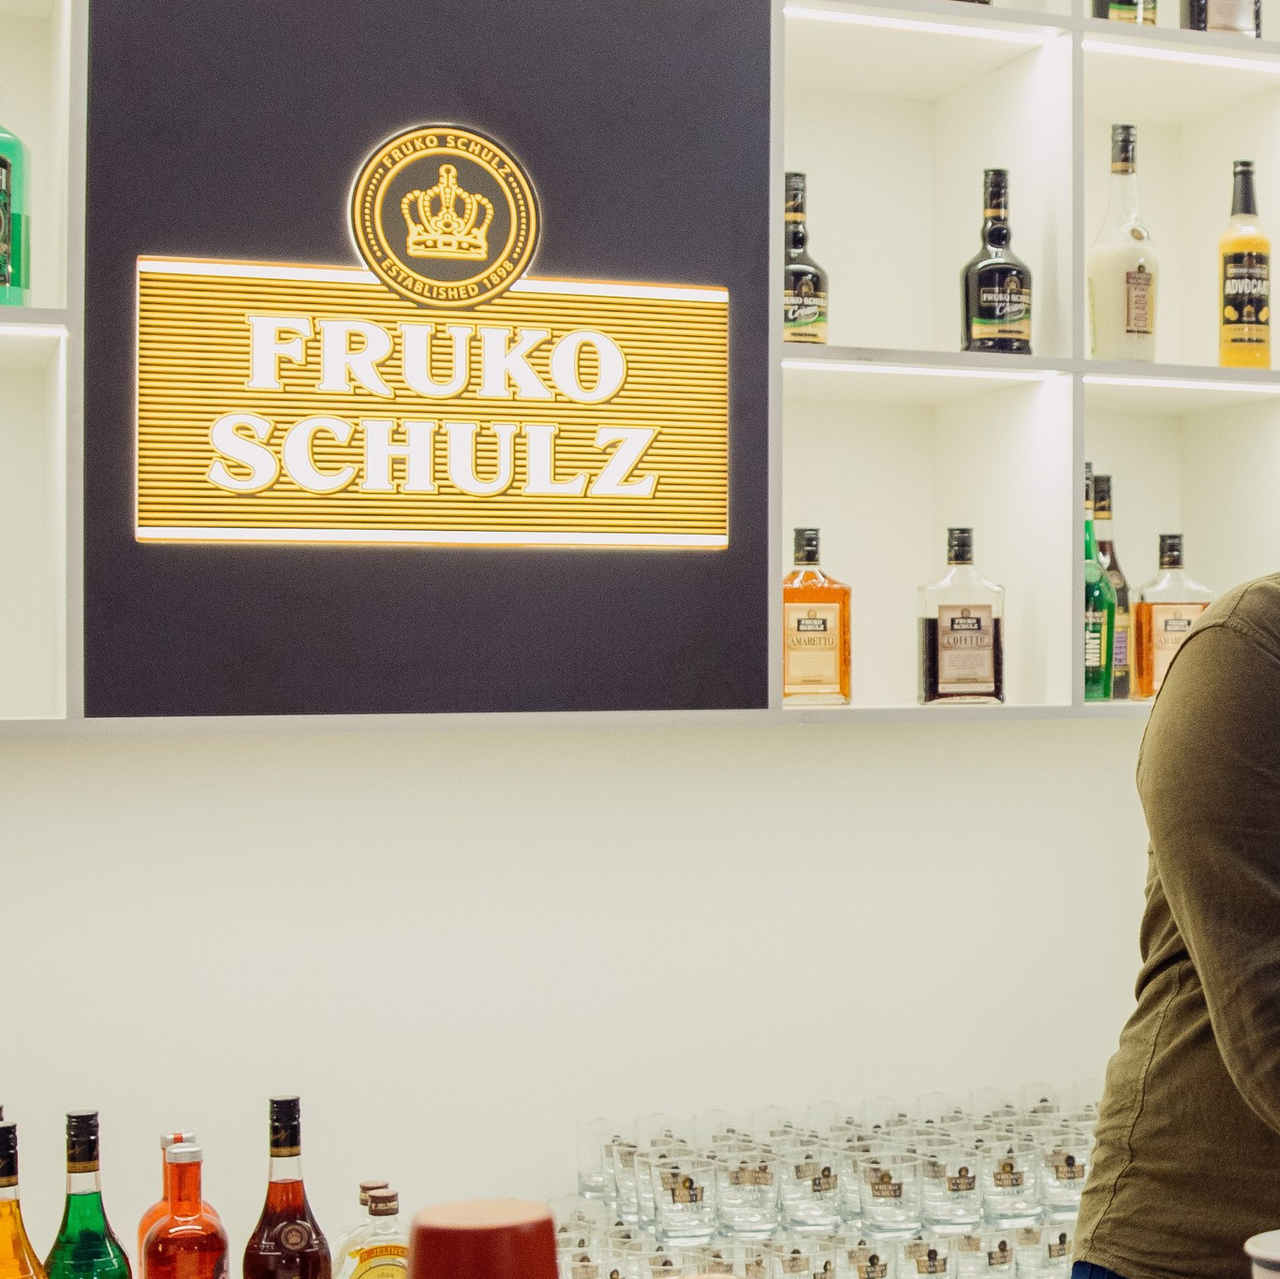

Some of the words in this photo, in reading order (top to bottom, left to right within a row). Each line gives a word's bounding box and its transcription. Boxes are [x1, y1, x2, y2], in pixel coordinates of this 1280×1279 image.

[382, 135, 439, 169] FRUKO
[446, 135, 512, 178] SCHULZ
[381, 258, 480, 300] ESTABLISHED
[482, 260, 514, 290] 1898
[244, 313, 628, 404] FRUKO
[206, 411, 662, 500] SCHULZ
[790, 635, 834, 646] AMARETTO
[1085, 631, 1100, 666] MINT
[371, 1246, 408, 1258] JELINE
